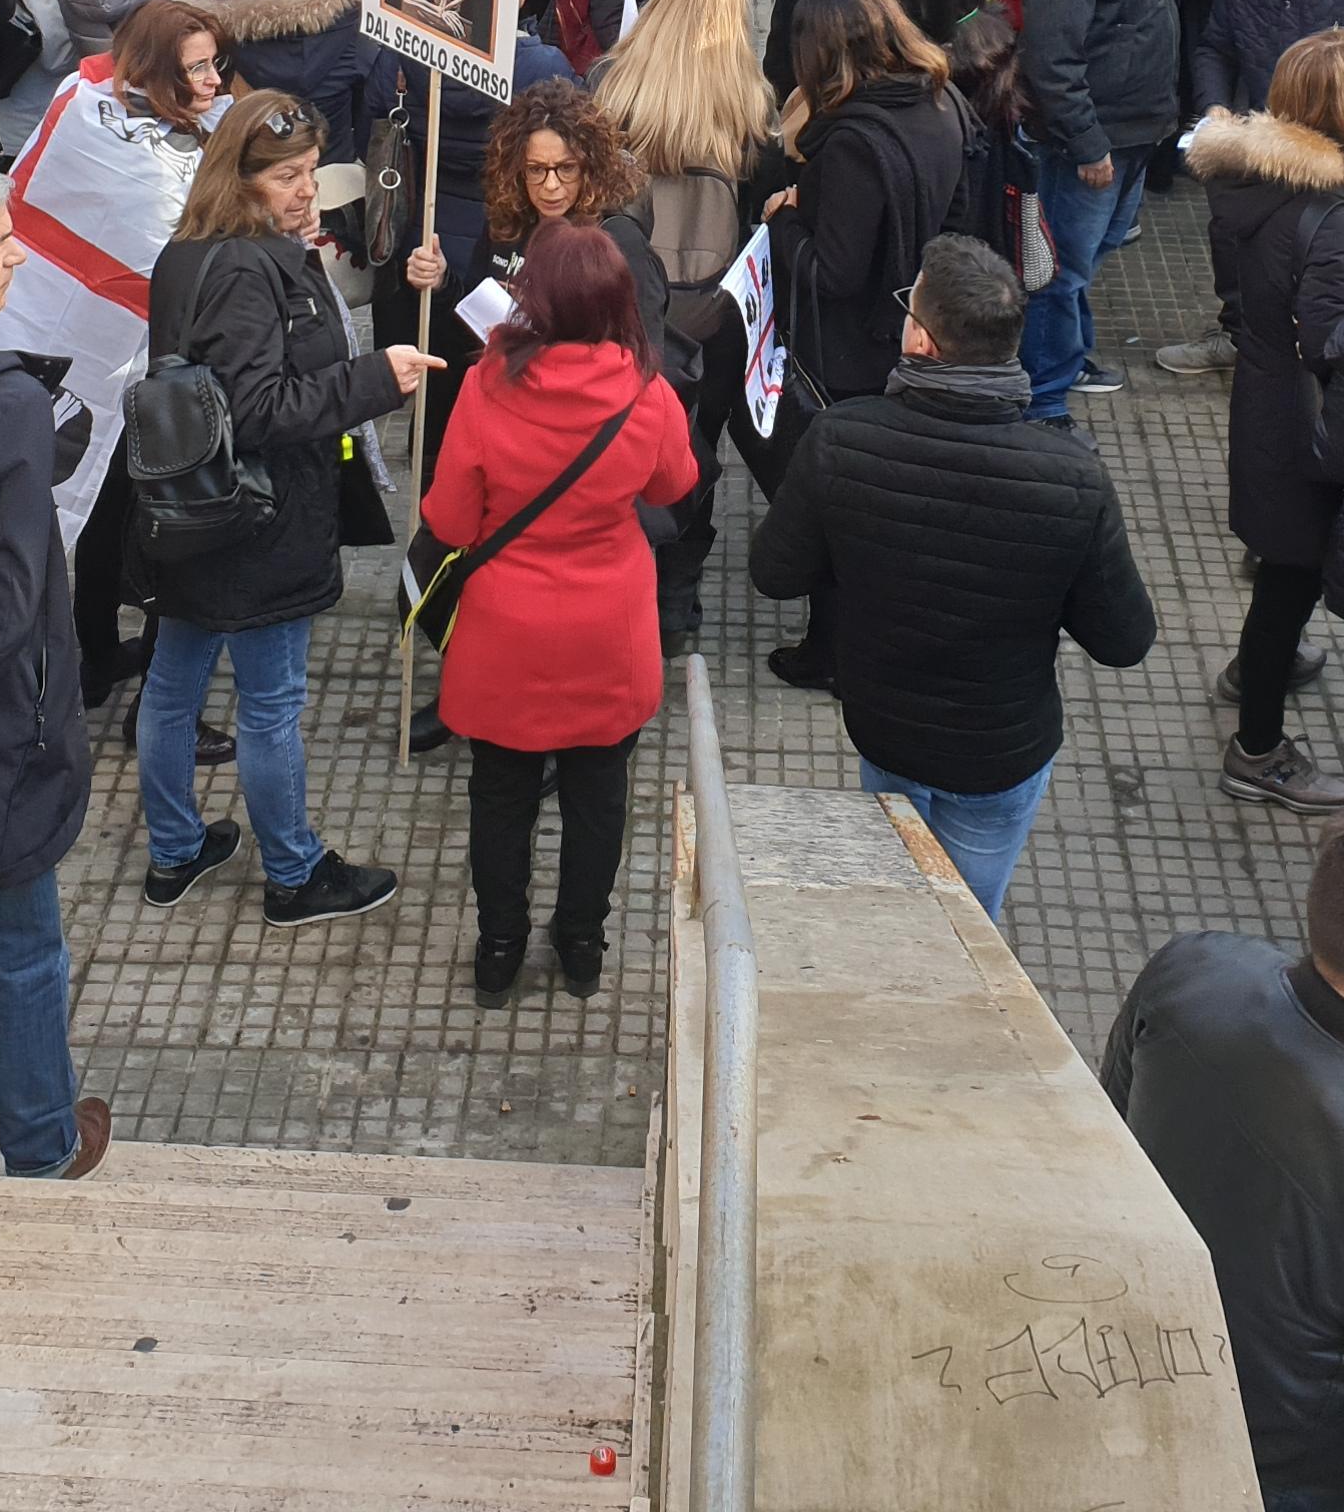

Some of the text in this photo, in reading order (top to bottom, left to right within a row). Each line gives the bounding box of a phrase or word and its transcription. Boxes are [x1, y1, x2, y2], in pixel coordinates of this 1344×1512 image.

[365, 11, 510, 102] DAL SECOLO SCORSO
